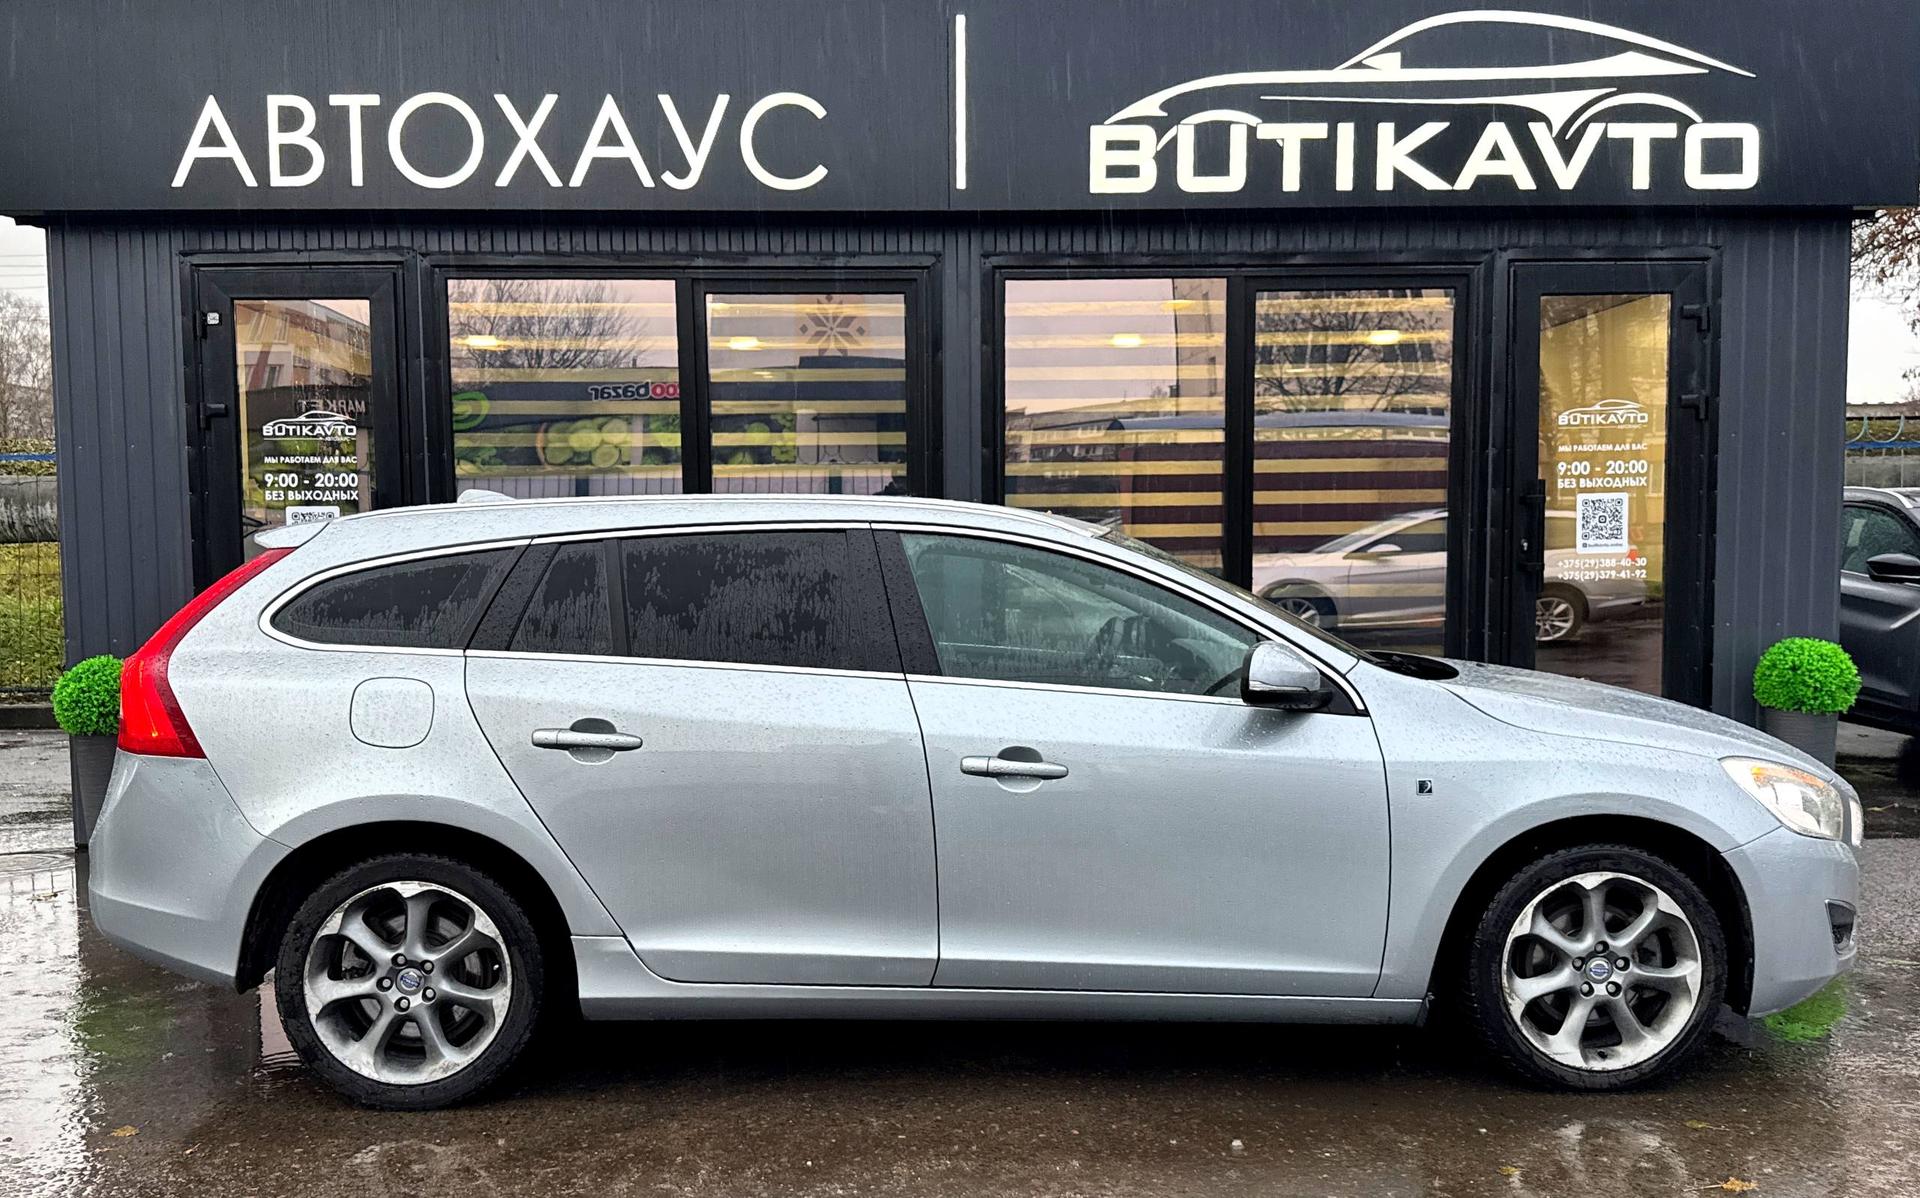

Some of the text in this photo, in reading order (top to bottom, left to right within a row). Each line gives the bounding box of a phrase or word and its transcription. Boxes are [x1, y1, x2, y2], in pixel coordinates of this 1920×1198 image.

[171, 91, 829, 191] АВТОХАУС
[1089, 121, 1760, 194] BUTIKAVTO
[1558, 412, 1648, 425] BUTIKAVTO
[262, 425, 356, 436] BUTIKAVTO
[1558, 443, 1648, 452] МЫ РАБОТАЕМ ДЛЯ ВАС
[264, 456, 358, 465] МЫ РАБОТАЕМ ДЛЯ ВАС
[1557, 461, 1591, 476] 9:00
[1605, 460, 1648, 475] 20:00
[264, 474, 298, 488] 9:00
[314, 474, 358, 488] 20:00
[1557, 476, 1648, 489] БЕЗ ВЫХОДНЫХ
[265, 490, 359, 502] БЕЗ ВЫХОДНЫХ
[1557, 569, 1648, 582] +375(29)379-41-92
